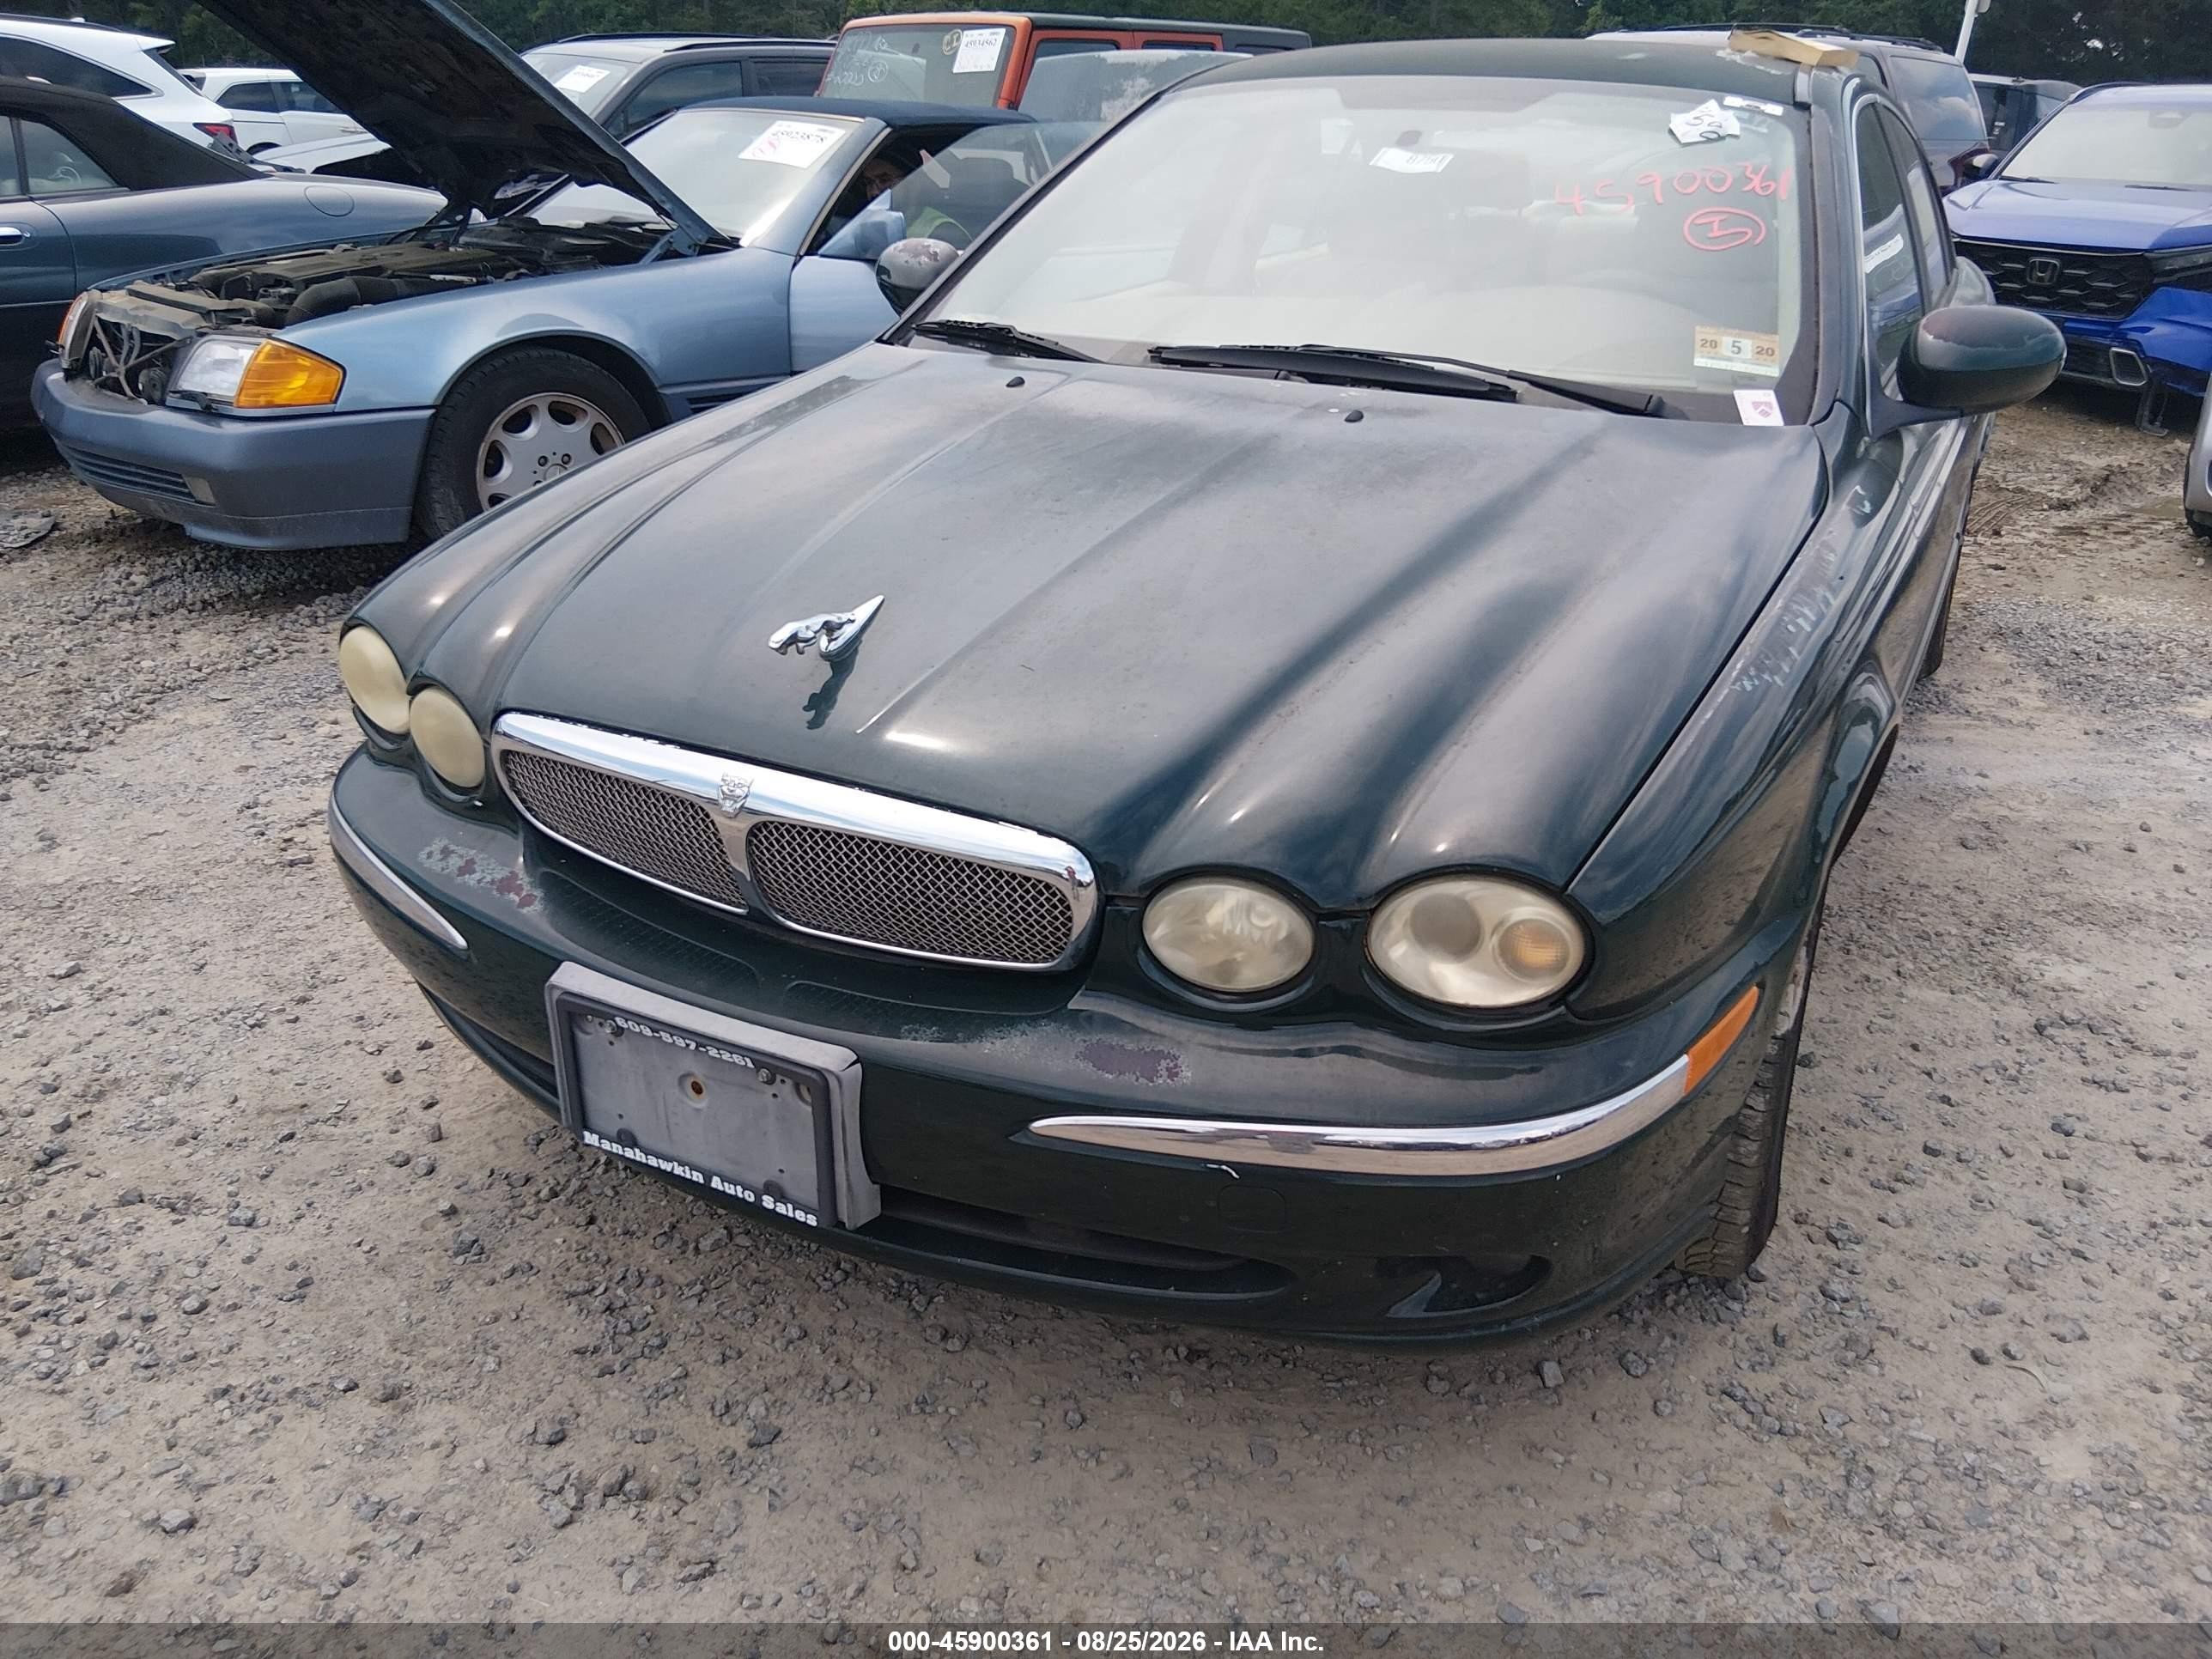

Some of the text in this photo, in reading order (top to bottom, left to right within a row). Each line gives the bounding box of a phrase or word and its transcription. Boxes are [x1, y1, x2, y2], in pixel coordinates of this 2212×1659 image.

[1699, 337, 1776, 357] 20 5 20
[583, 1130, 818, 1228] Manahawkin Auto Sales
